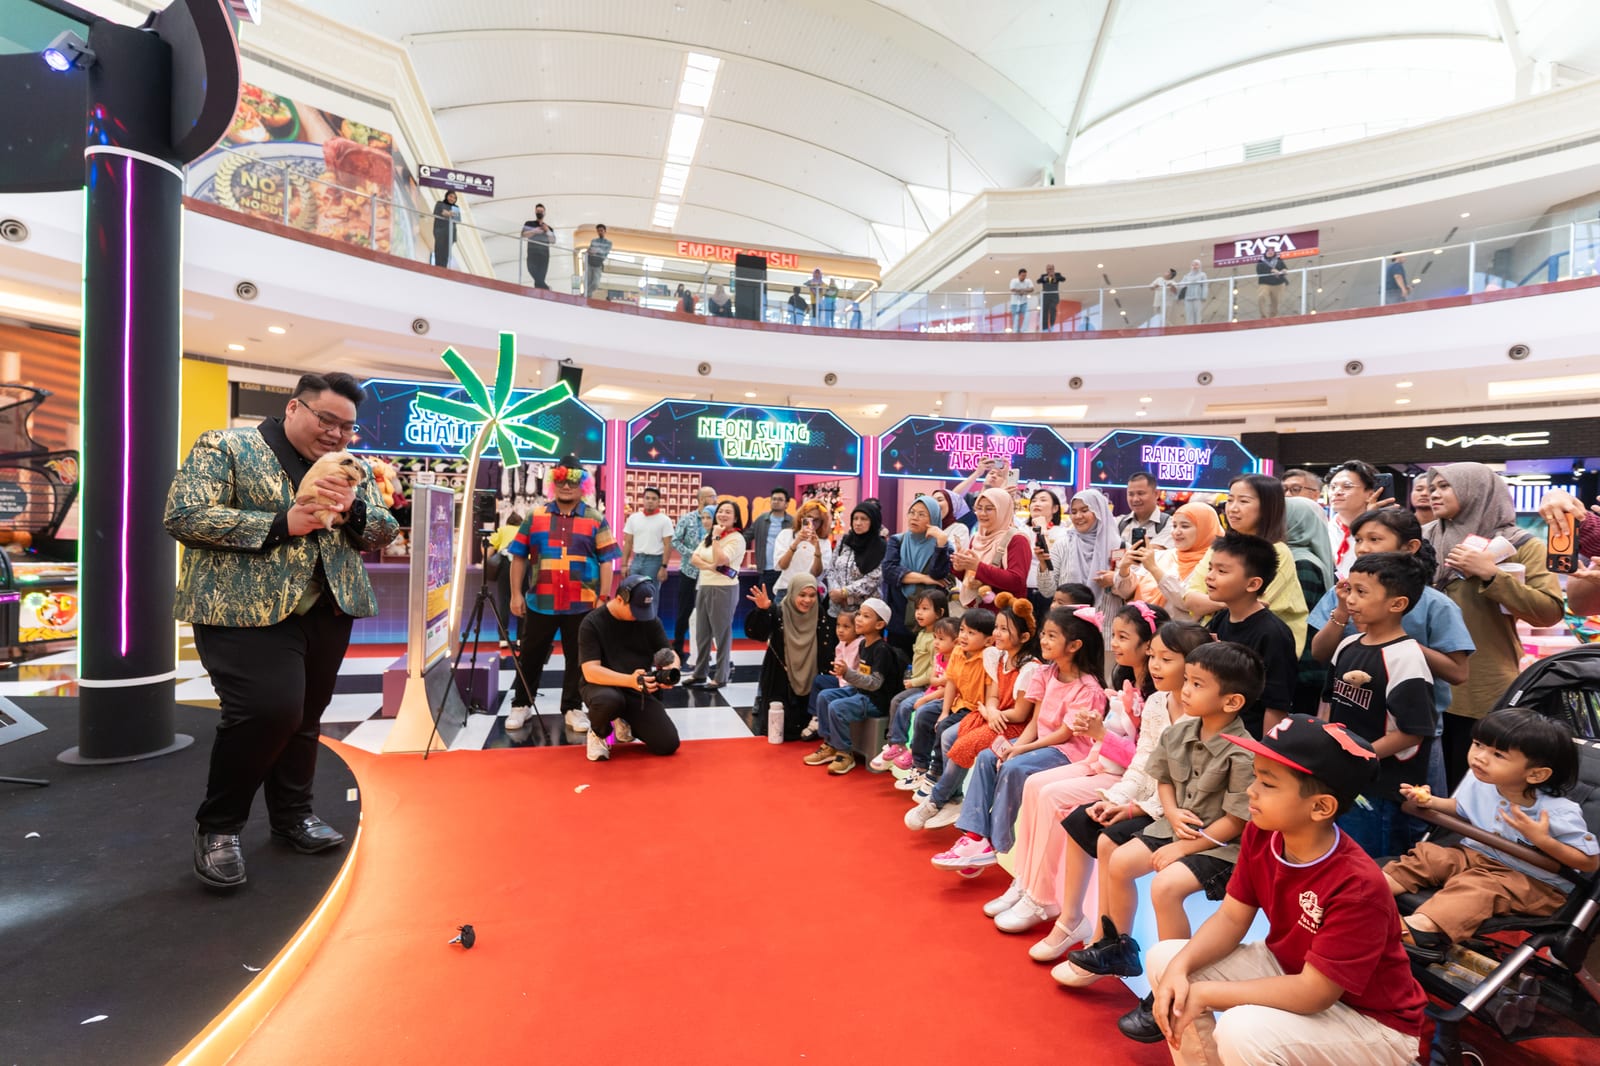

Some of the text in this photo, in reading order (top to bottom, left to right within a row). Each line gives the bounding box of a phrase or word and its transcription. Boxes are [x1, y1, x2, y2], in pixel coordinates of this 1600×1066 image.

[253, 190, 283, 205] BEEF
[1234, 234, 1296, 258] RASA
[698, 417, 810, 445] NEON SLING
[724, 439, 785, 461] BLAST
[935, 432, 1027, 455] SMILE SHOT
[1142, 445, 1211, 465] RAINBOW
[1159, 463, 1195, 481] RUSH
